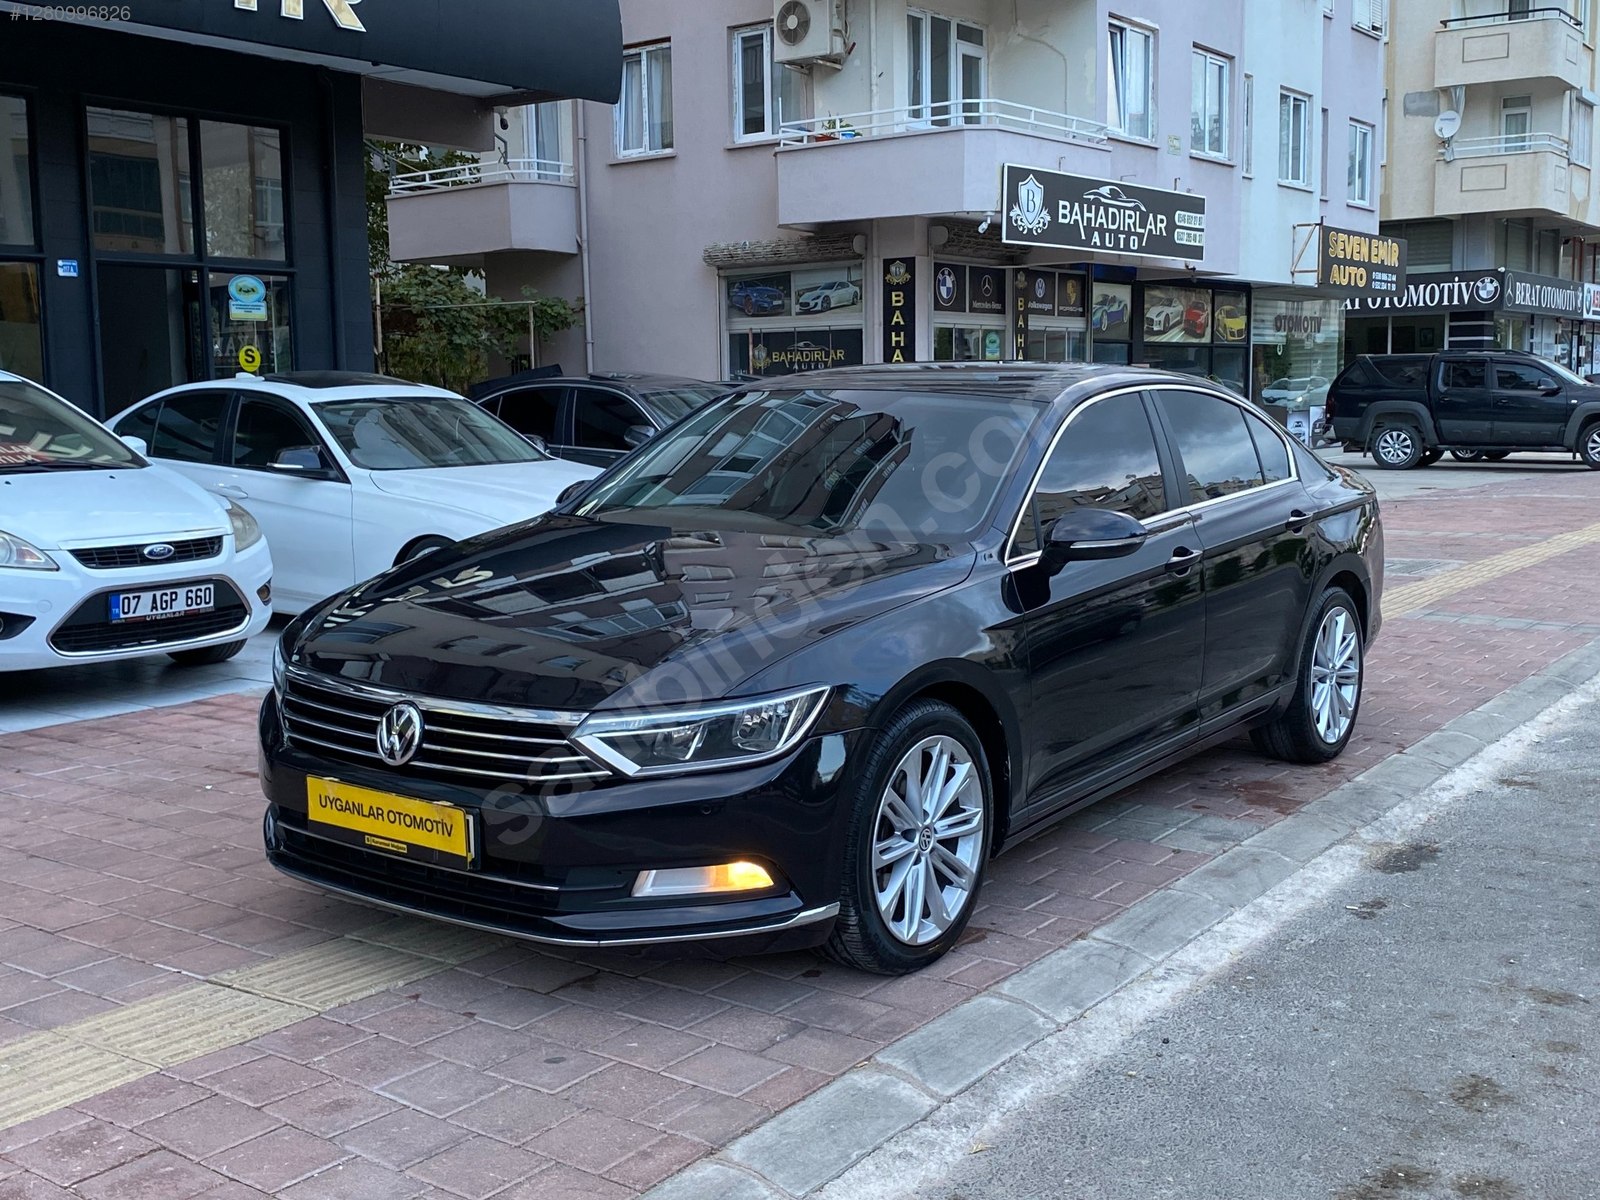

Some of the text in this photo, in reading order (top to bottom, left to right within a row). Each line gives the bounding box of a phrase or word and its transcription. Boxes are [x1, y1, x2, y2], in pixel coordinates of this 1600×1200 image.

[1058, 200, 1168, 246] BAHADIRLAR
[1091, 232, 1138, 250] AUTO
[1328, 231, 1399, 268] SEVEN EMİR
[1329, 264, 1367, 288] AUTO
[1515, 282, 1540, 307] BERAT
[244, 349, 256, 363] S
[772, 350, 845, 368] BAHADIRLAR
[793, 362, 825, 370] AUTO
[122, 587, 212, 615] 07 AGP 660
[319, 794, 454, 837] UYGANLAR OTOMOTİV
